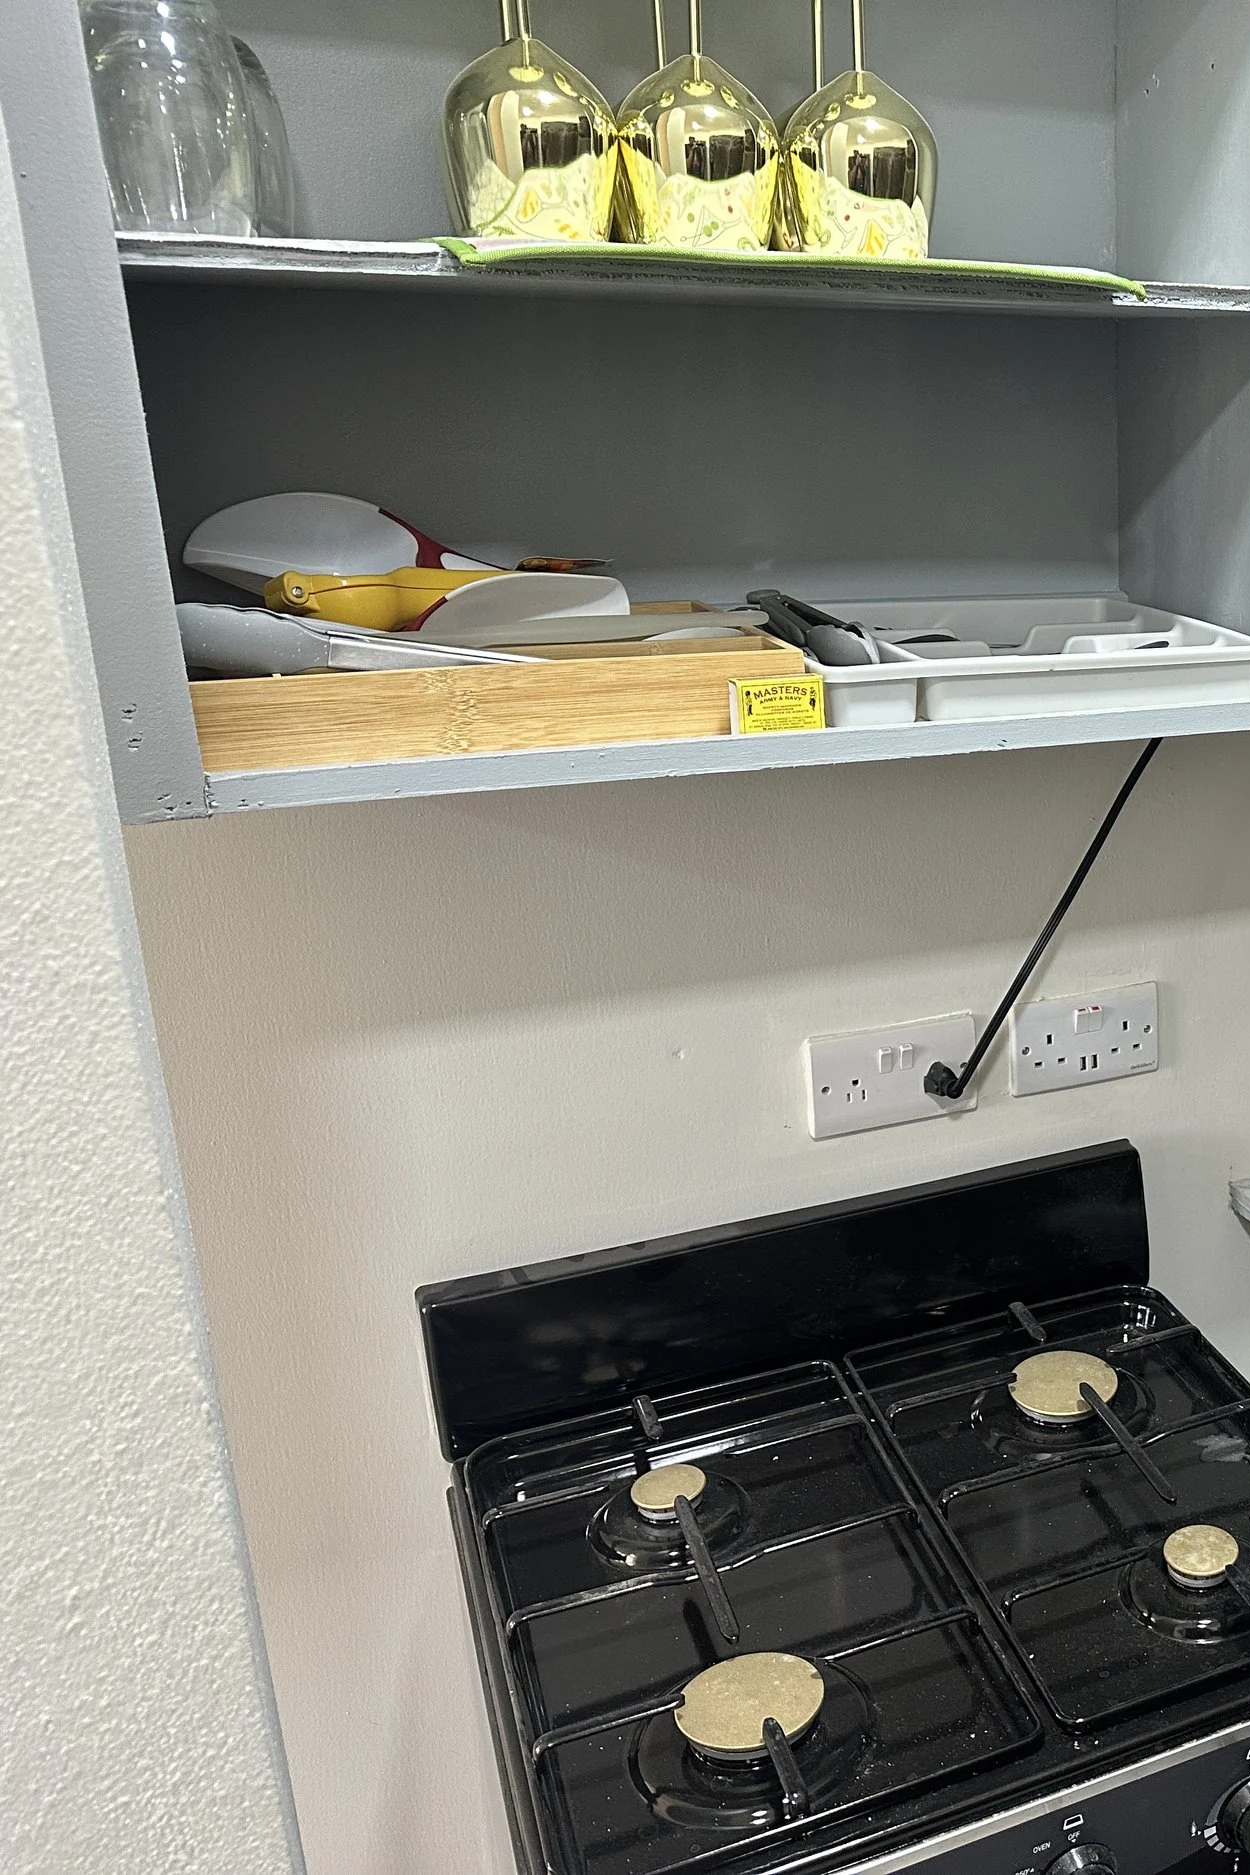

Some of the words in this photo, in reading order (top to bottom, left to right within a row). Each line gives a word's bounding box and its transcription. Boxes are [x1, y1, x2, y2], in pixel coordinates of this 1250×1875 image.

[753, 686, 808, 700] MASTERS
[760, 696, 778, 704] ARMY
[1068, 1830, 1081, 1841] OFF
[1032, 1842, 1051, 1854] OVEN
